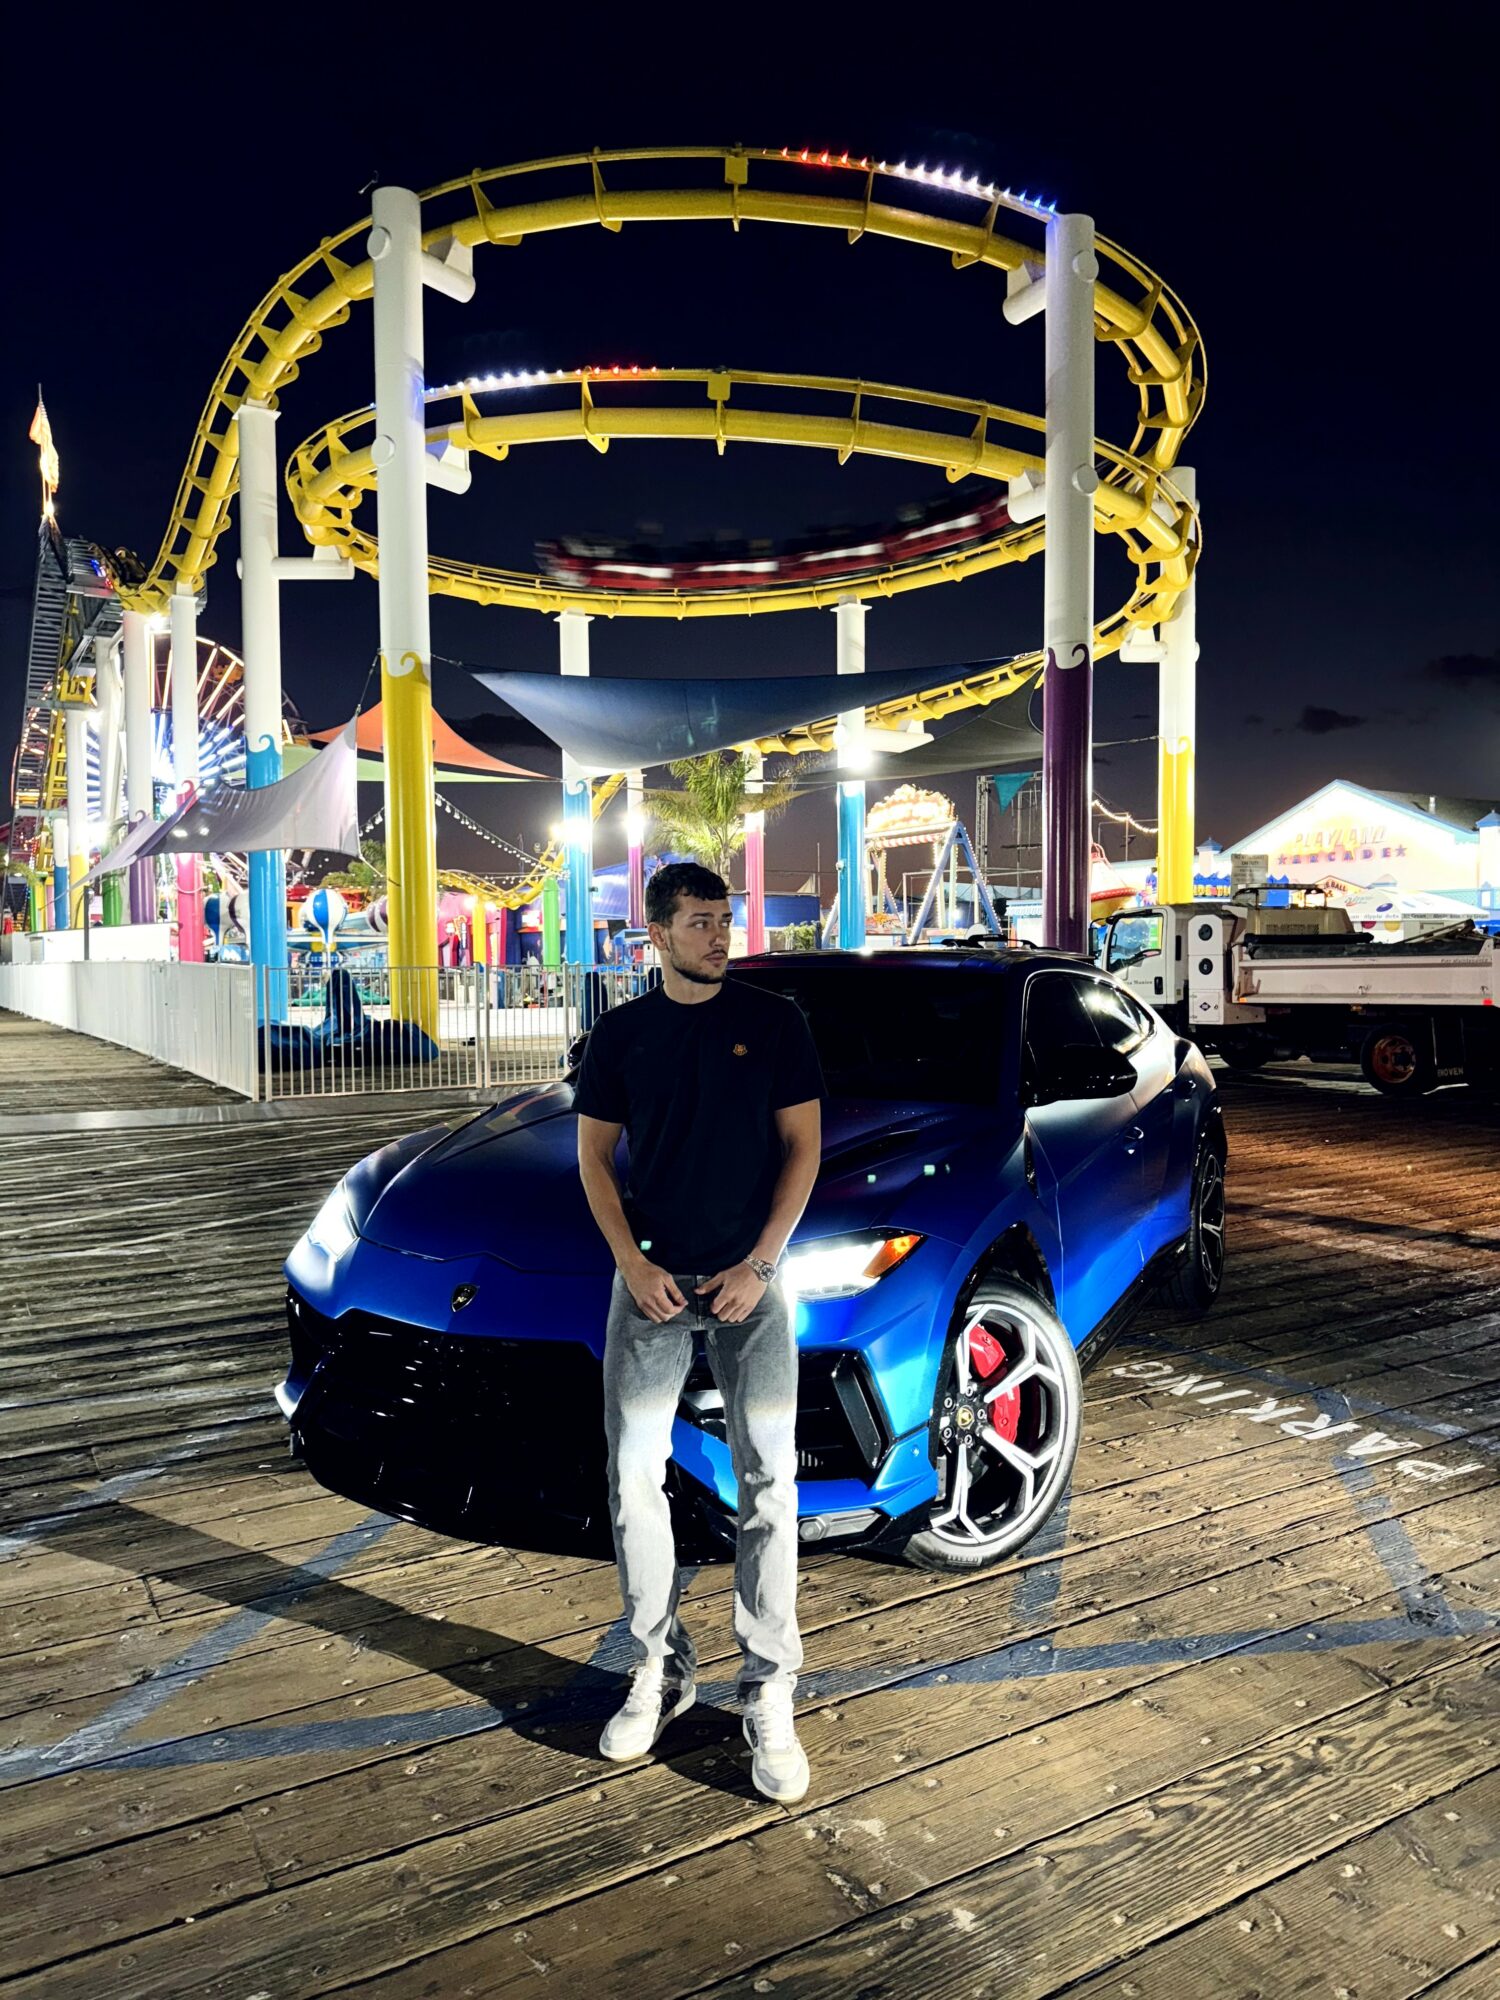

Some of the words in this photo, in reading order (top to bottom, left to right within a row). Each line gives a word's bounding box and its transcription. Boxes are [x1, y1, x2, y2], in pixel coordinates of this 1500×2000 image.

[1295, 825, 1386, 847] PLAYLAND
[1292, 848, 1392, 865] ARCADE
[1113, 1361, 1485, 1482] PARKING
